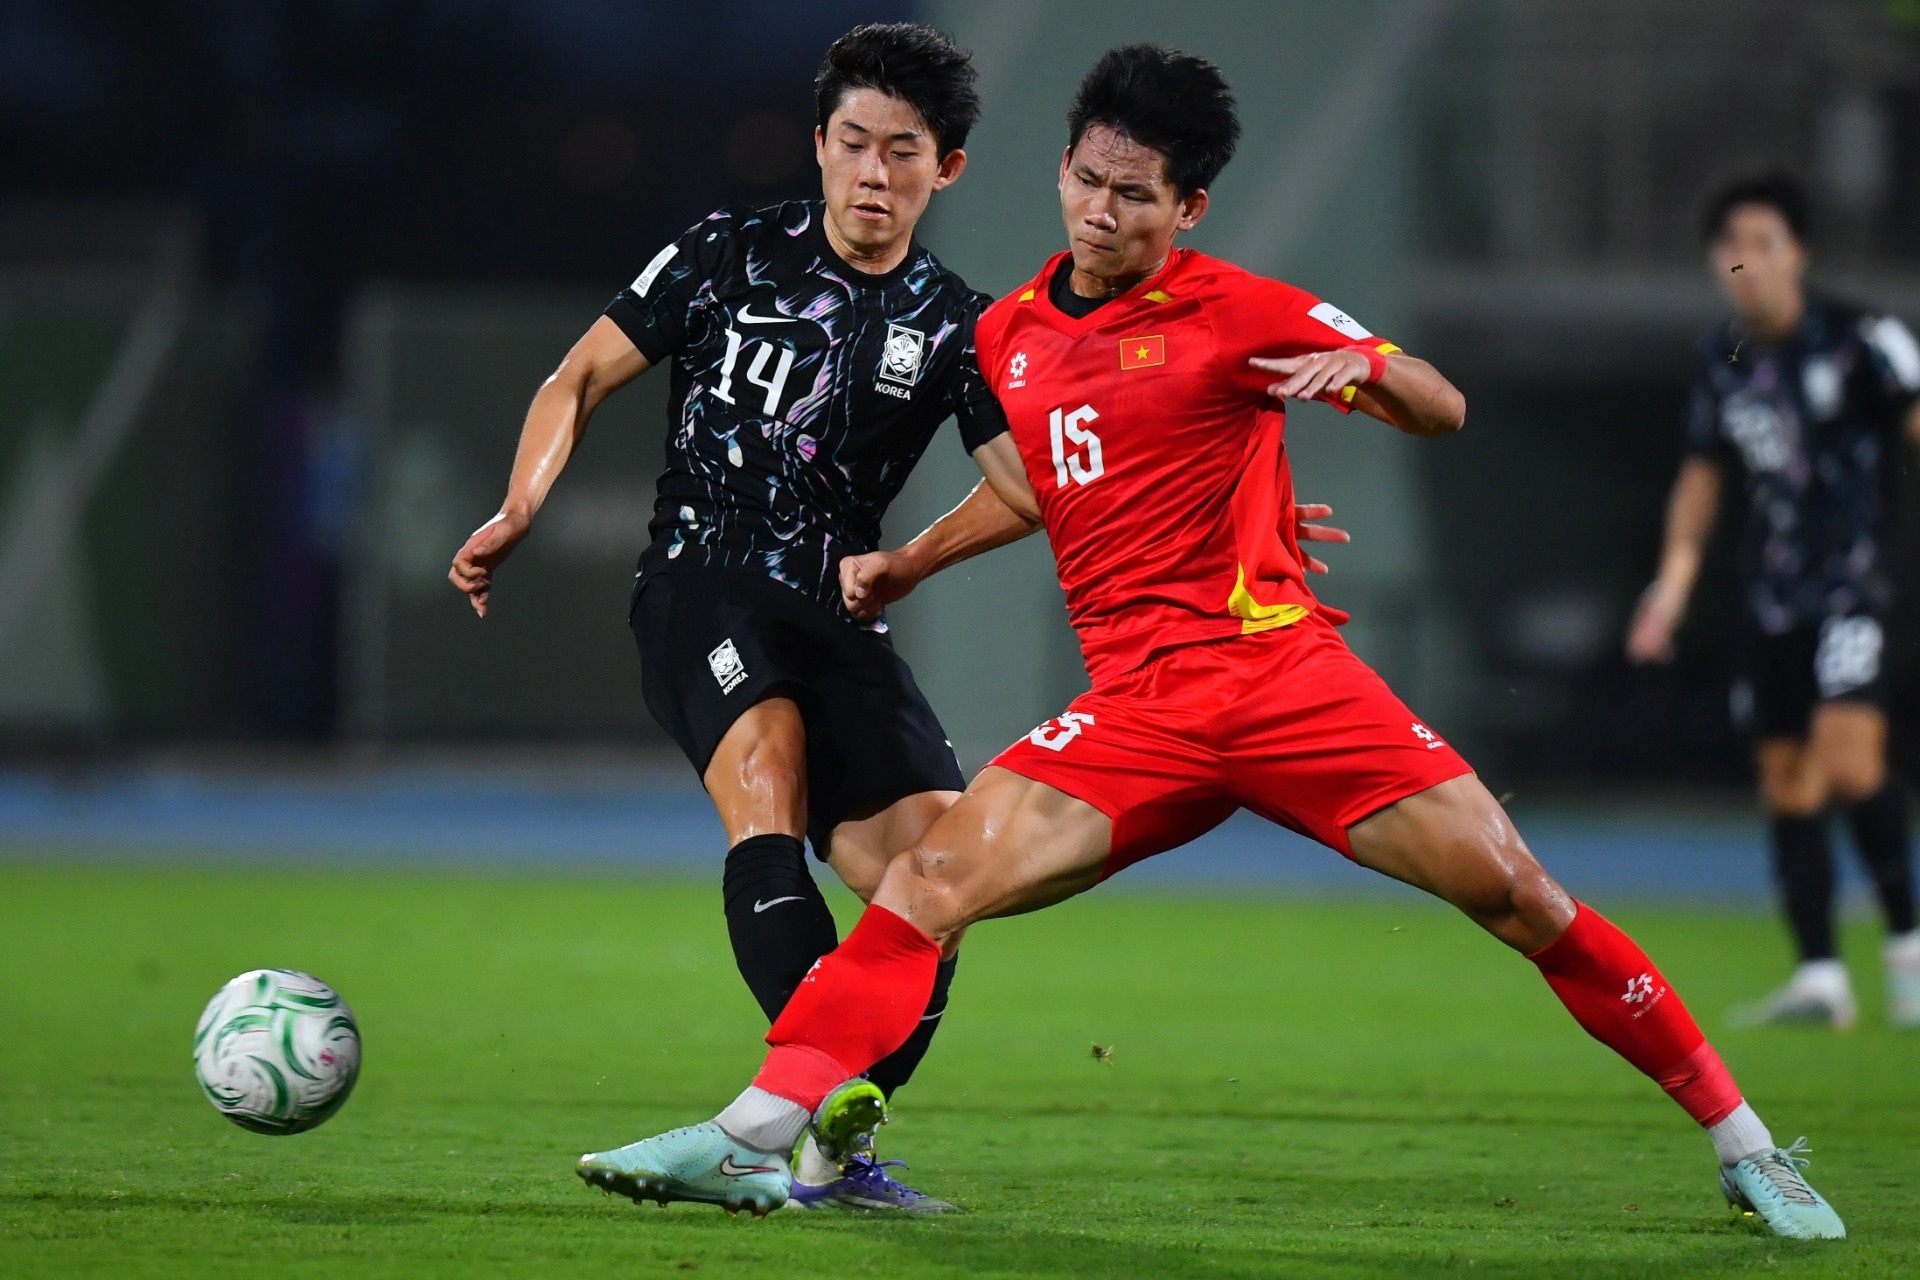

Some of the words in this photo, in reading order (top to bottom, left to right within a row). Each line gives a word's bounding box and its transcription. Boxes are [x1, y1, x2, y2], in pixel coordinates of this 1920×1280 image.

[709, 328, 795, 417] 14
[875, 381, 911, 401] KOREA
[1049, 404, 1105, 489] 15
[722, 671, 749, 696] KOREA
